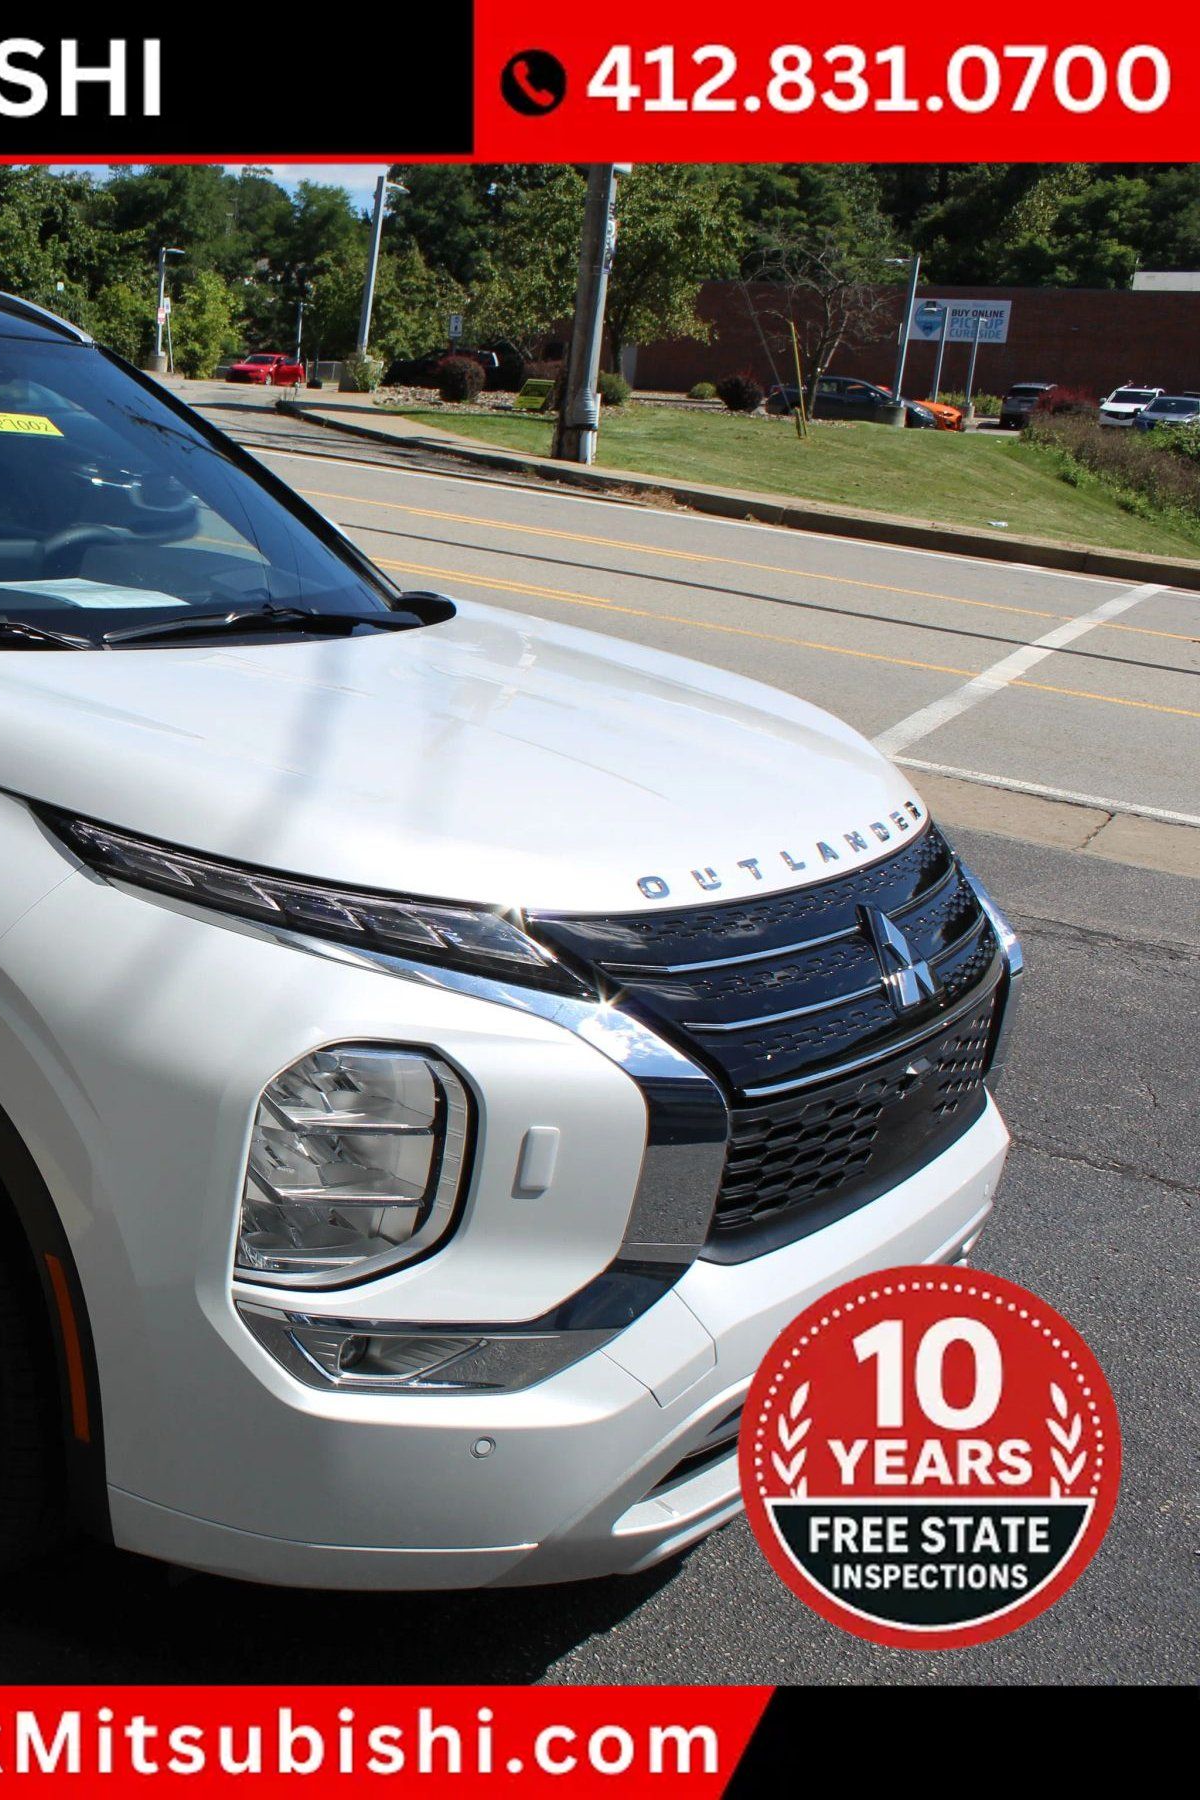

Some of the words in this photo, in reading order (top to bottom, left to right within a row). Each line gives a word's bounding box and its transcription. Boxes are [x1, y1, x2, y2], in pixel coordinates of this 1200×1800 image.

[951, 309, 971, 318] BUY
[971, 309, 1006, 318] ONLINE
[636, 800, 922, 900] OUTLANDER
